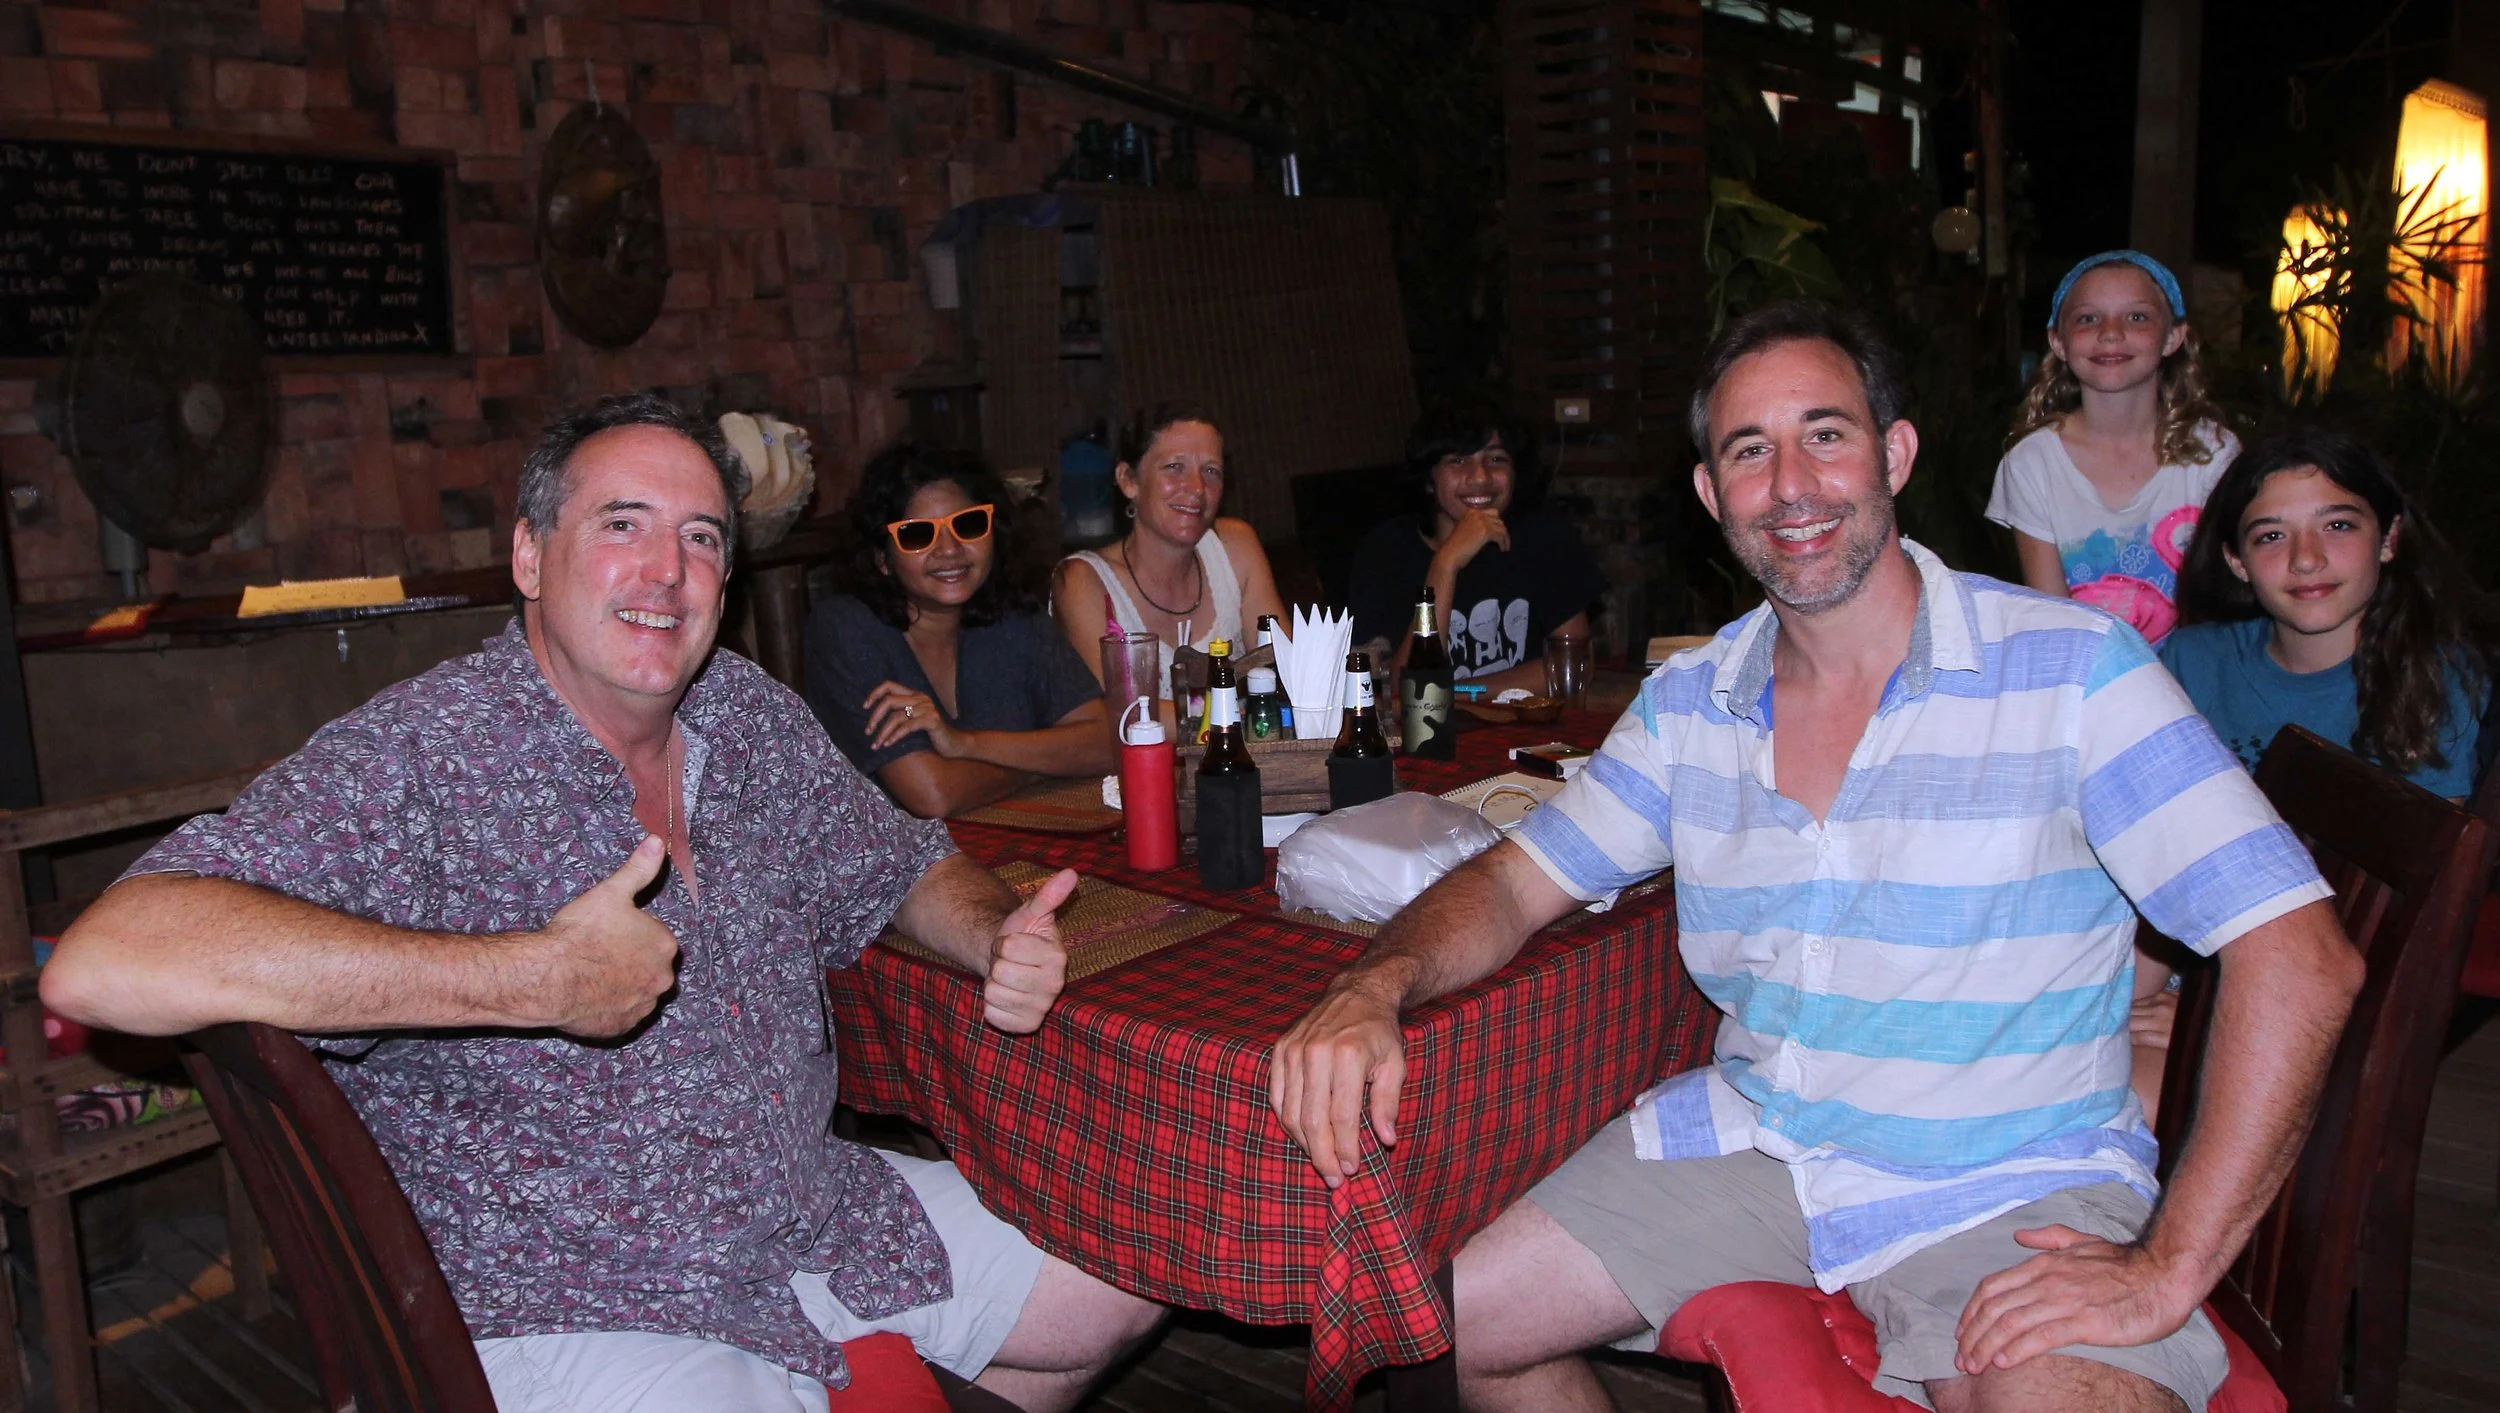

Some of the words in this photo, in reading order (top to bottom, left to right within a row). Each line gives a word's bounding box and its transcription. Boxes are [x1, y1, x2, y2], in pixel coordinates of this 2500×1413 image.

[0, 144, 56, 174] RY,
[72, 150, 112, 171] WE
[98, 178, 129, 200] TO
[208, 188, 230, 205] IN
[60, 255, 87, 275] OF
[379, 292, 419, 307] WITH
[266, 328, 410, 349] UNDERTANDING
